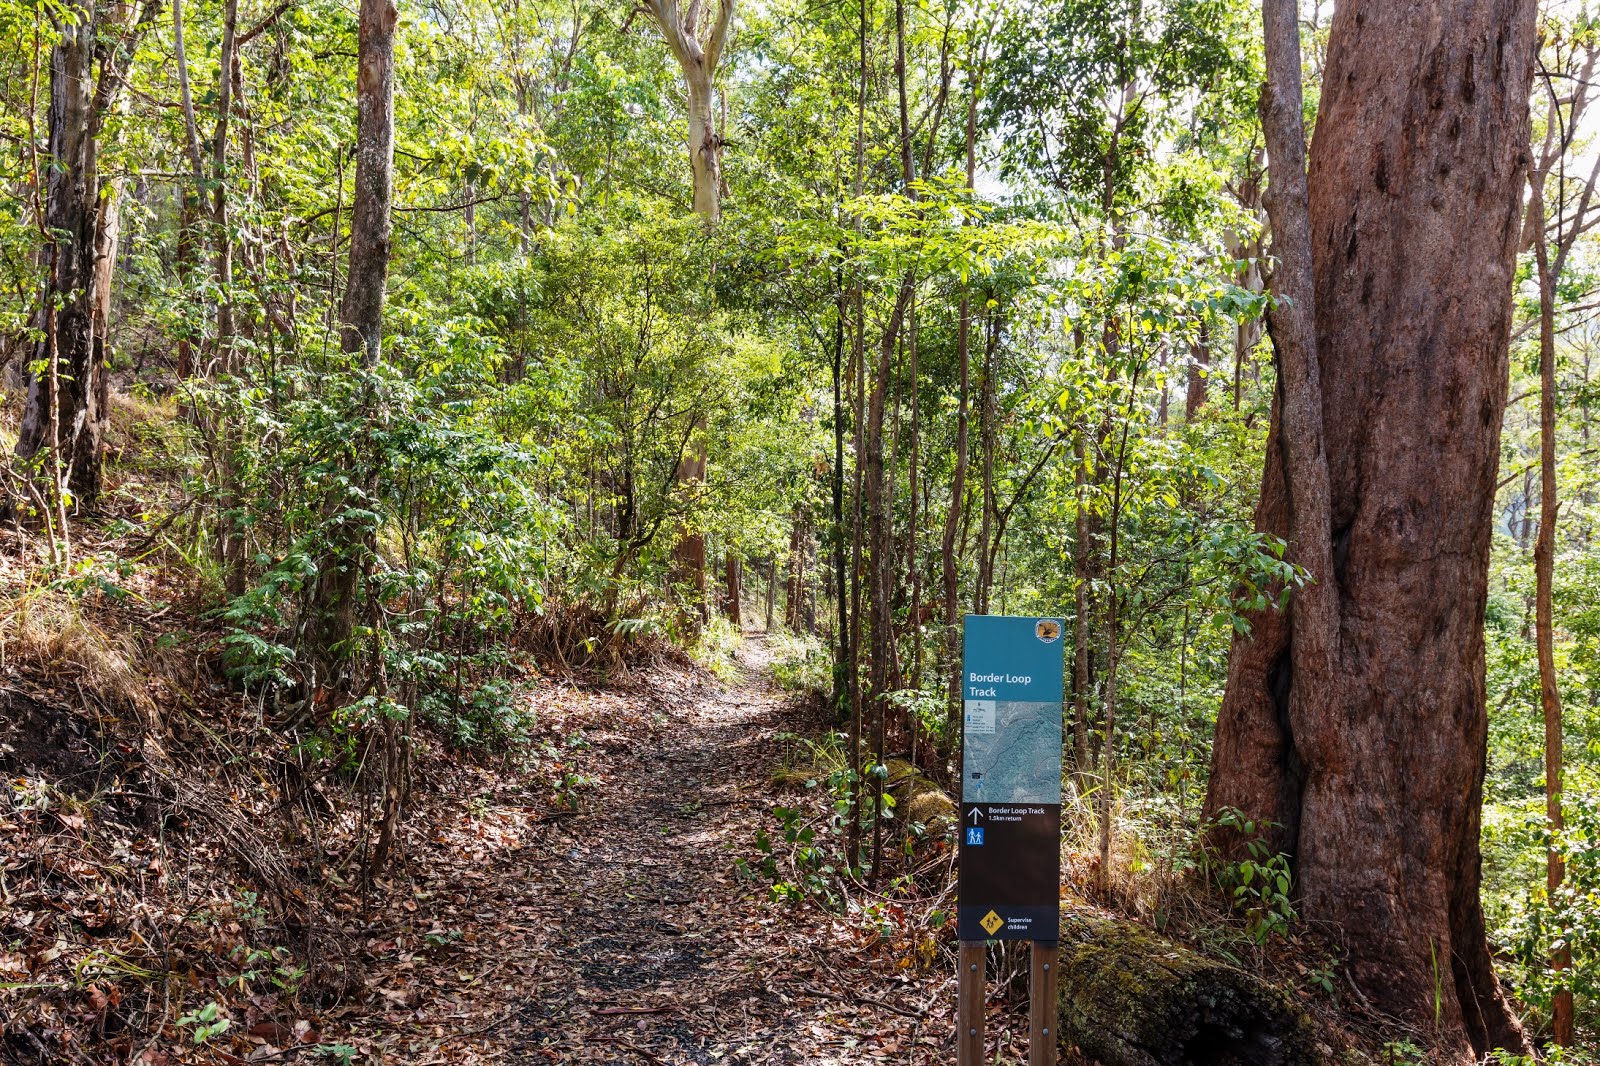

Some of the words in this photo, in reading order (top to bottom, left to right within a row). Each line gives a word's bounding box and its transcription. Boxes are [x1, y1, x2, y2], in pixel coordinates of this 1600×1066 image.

[970, 673, 1004, 682] Border
[1006, 674, 1031, 685] Loop
[969, 687, 996, 697] Track
[1011, 807, 1027, 815] Loop
